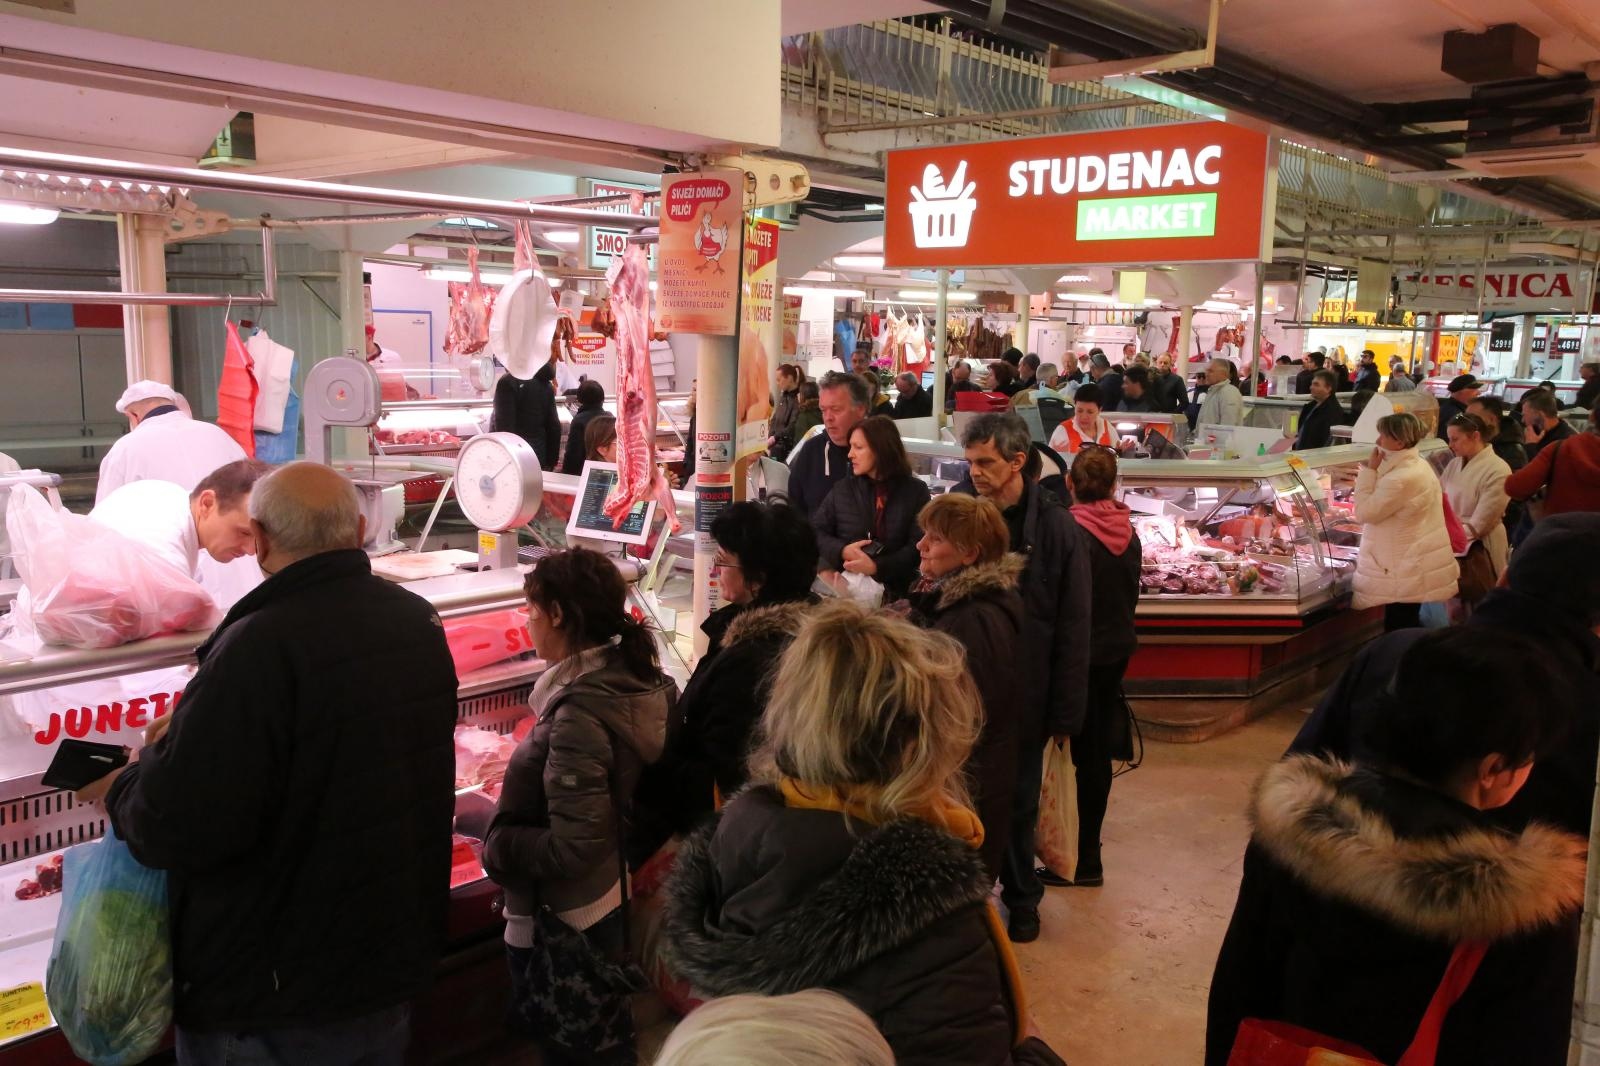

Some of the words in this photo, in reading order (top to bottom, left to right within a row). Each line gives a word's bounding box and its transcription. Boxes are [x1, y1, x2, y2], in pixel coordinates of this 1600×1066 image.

[1008, 145, 1223, 196] STUDENAC
[671, 185, 695, 199] SVJEŽI
[695, 183, 724, 198] DOMAĆI
[671, 201, 692, 215] PILIĆI
[1083, 202, 1207, 233] MARKET
